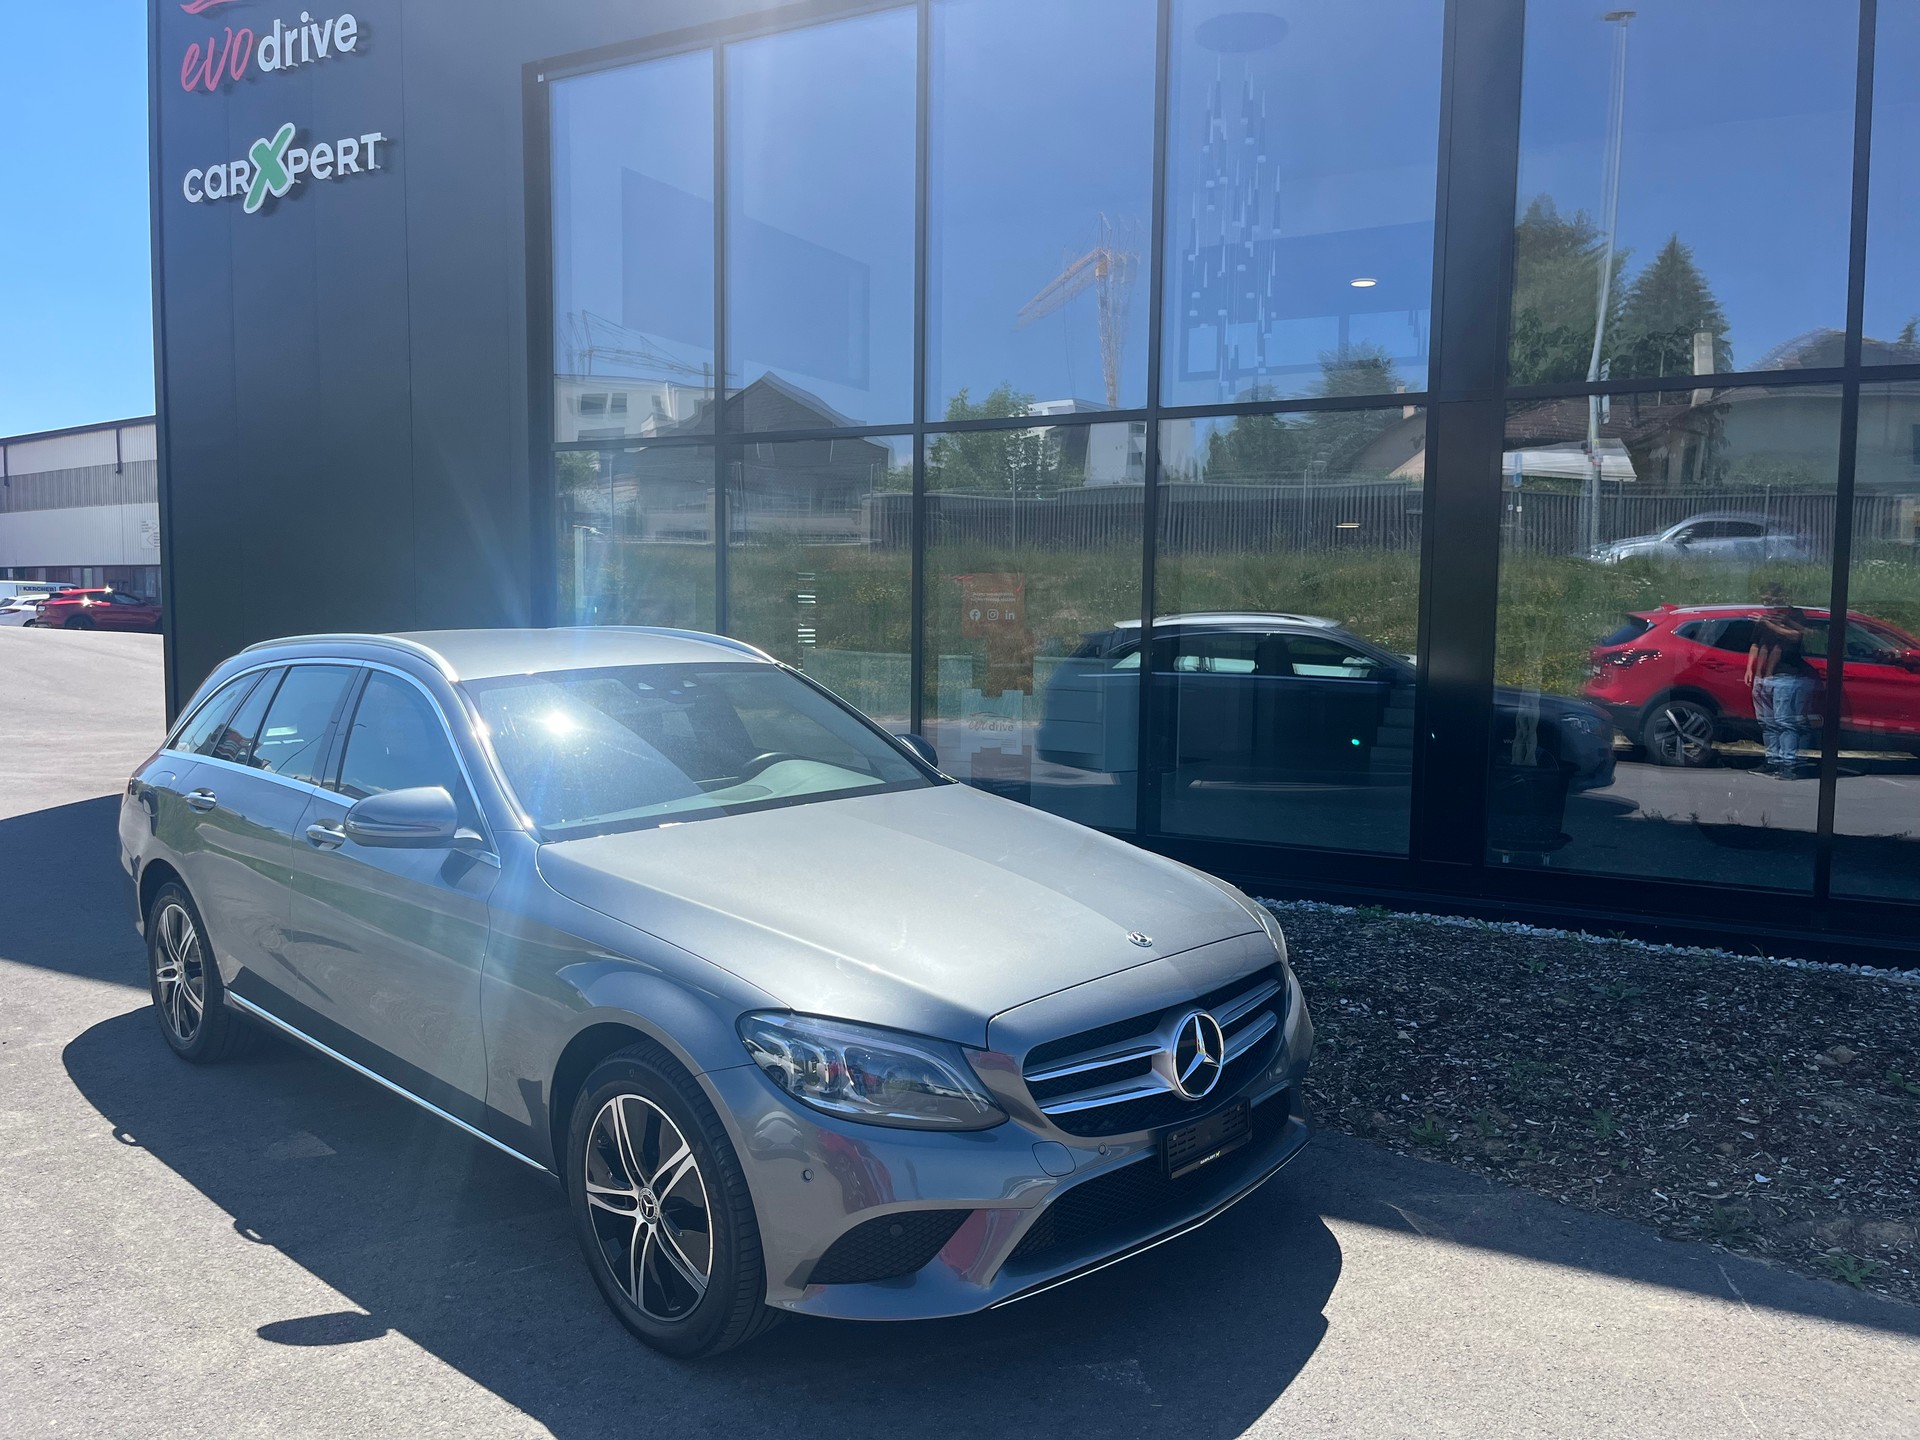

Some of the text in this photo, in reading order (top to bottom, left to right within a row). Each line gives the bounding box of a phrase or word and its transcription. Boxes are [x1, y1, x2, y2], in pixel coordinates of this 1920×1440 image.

[180, 11, 359, 92] evo drive
[988, 722, 1015, 732] drive
